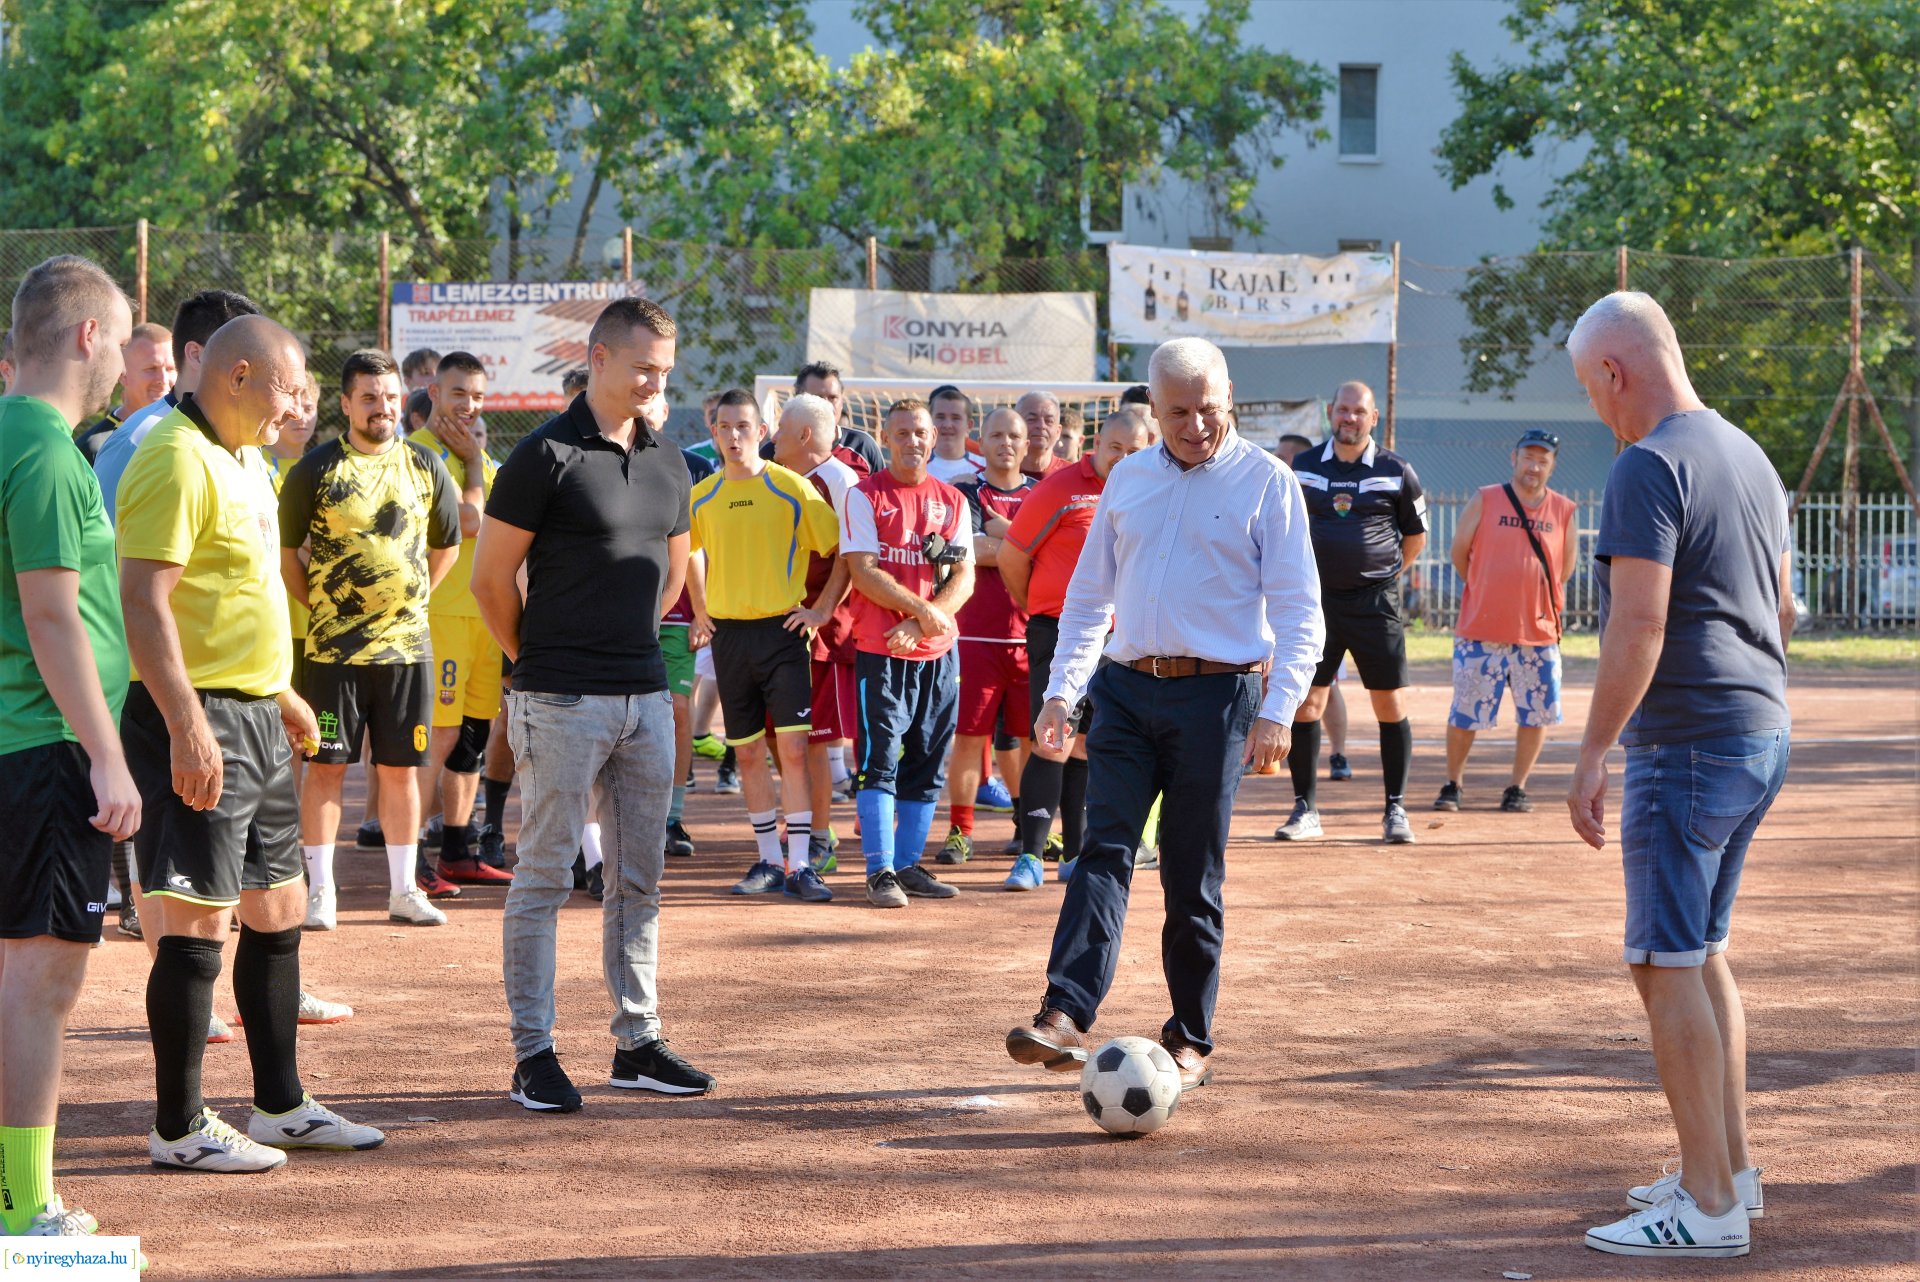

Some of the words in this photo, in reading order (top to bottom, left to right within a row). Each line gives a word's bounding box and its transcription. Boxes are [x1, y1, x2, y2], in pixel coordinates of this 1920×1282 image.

[432, 282, 627, 303] LEMEZCENTRUM
[1216, 295, 1291, 312] BIRS
[408, 307, 516, 323] TRAPÉZLEMEZ
[883, 315, 1008, 339] KONYHA
[908, 342, 1009, 365] MÖBEL
[1498, 515, 1553, 533] ADDAS
[441, 659, 457, 688] 8
[413, 724, 428, 752] 6
[808, 728, 832, 737] PATRICK
